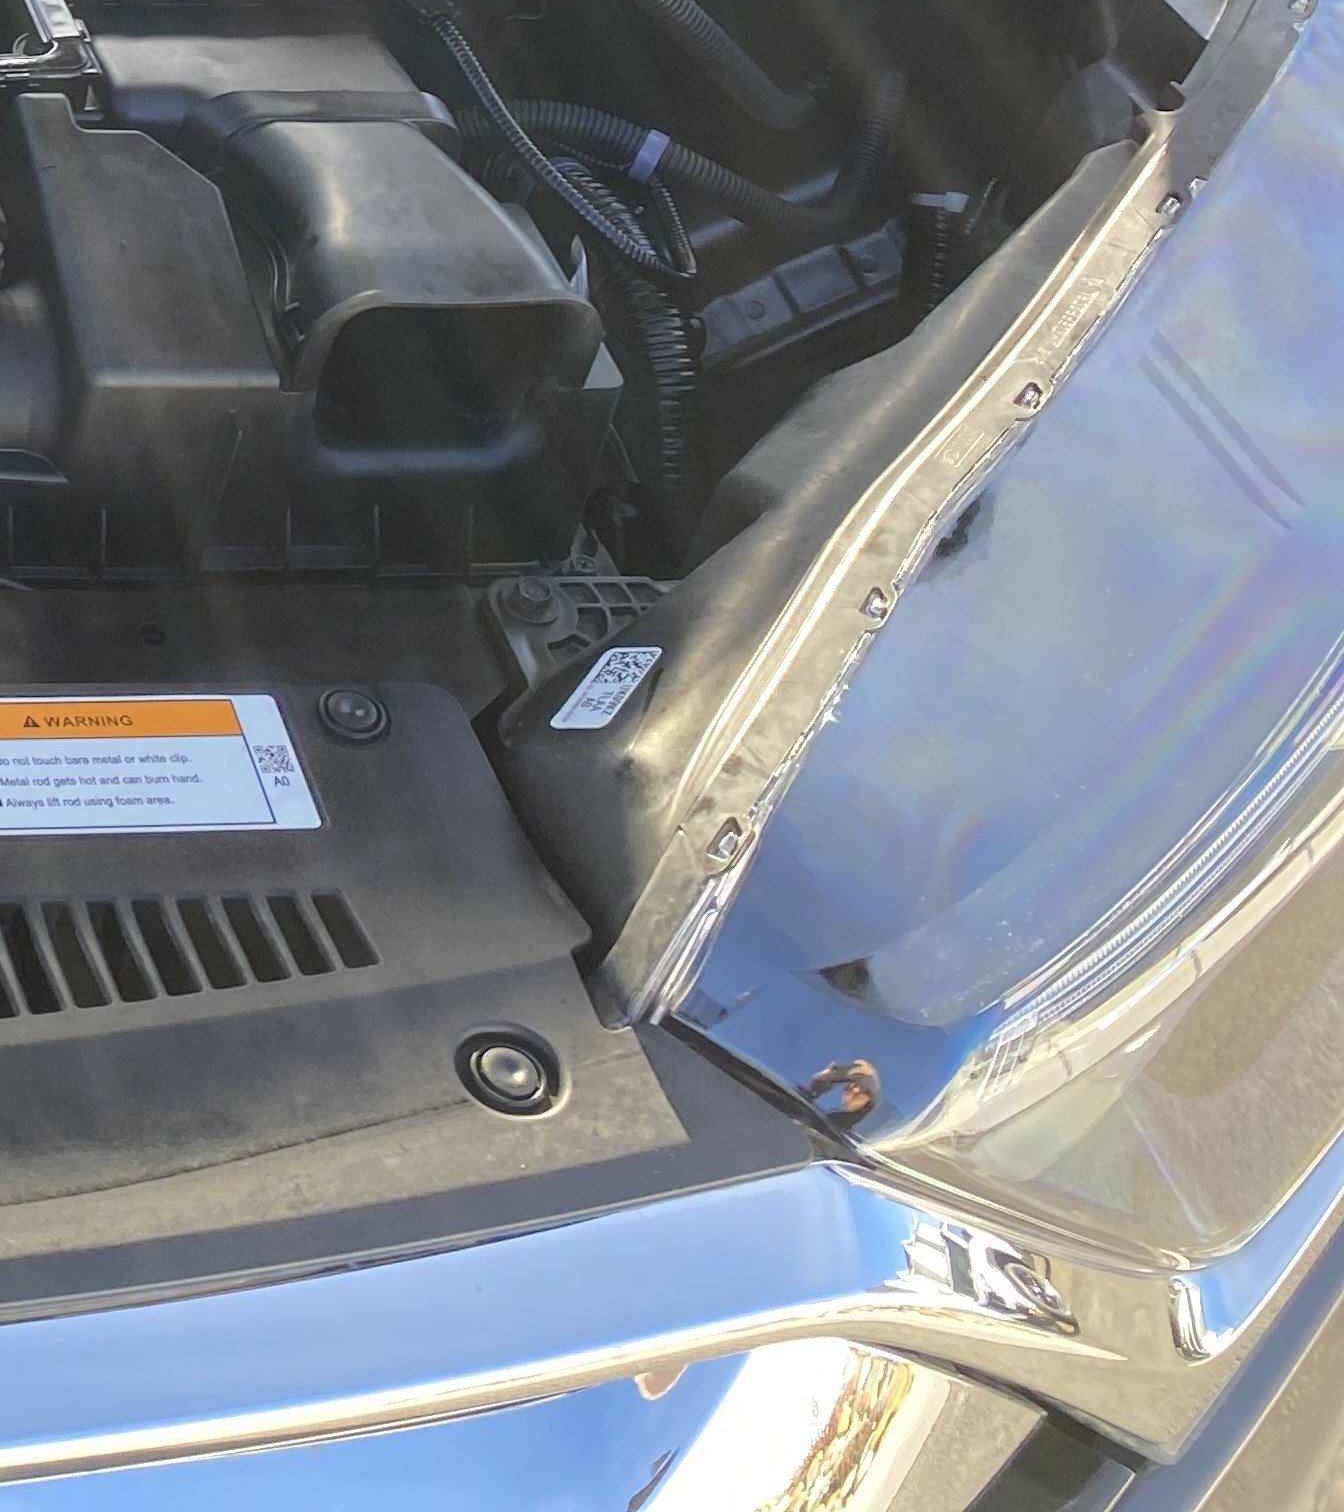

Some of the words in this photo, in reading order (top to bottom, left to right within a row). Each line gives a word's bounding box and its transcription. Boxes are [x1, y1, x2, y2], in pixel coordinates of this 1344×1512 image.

[43, 715, 133, 728] WARNING
[12, 756, 30, 766] not
[32, 755, 62, 766] touch
[64, 755, 90, 765] bare
[92, 754, 122, 764] metal
[124, 756, 135, 764] or
[138, 754, 167, 764] white
[0, 777, 30, 786] Metal
[33, 776, 51, 786] rod
[53, 776, 77, 788] gets
[79, 776, 97, 786] hot
[99, 774, 120, 785] and
[122, 775, 143, 785] can
[6, 797, 45, 809] Always
[46, 796, 61, 807] lift
[63, 796, 81, 807] rod
[83, 796, 114, 808] using
[115, 795, 144, 806] foam
